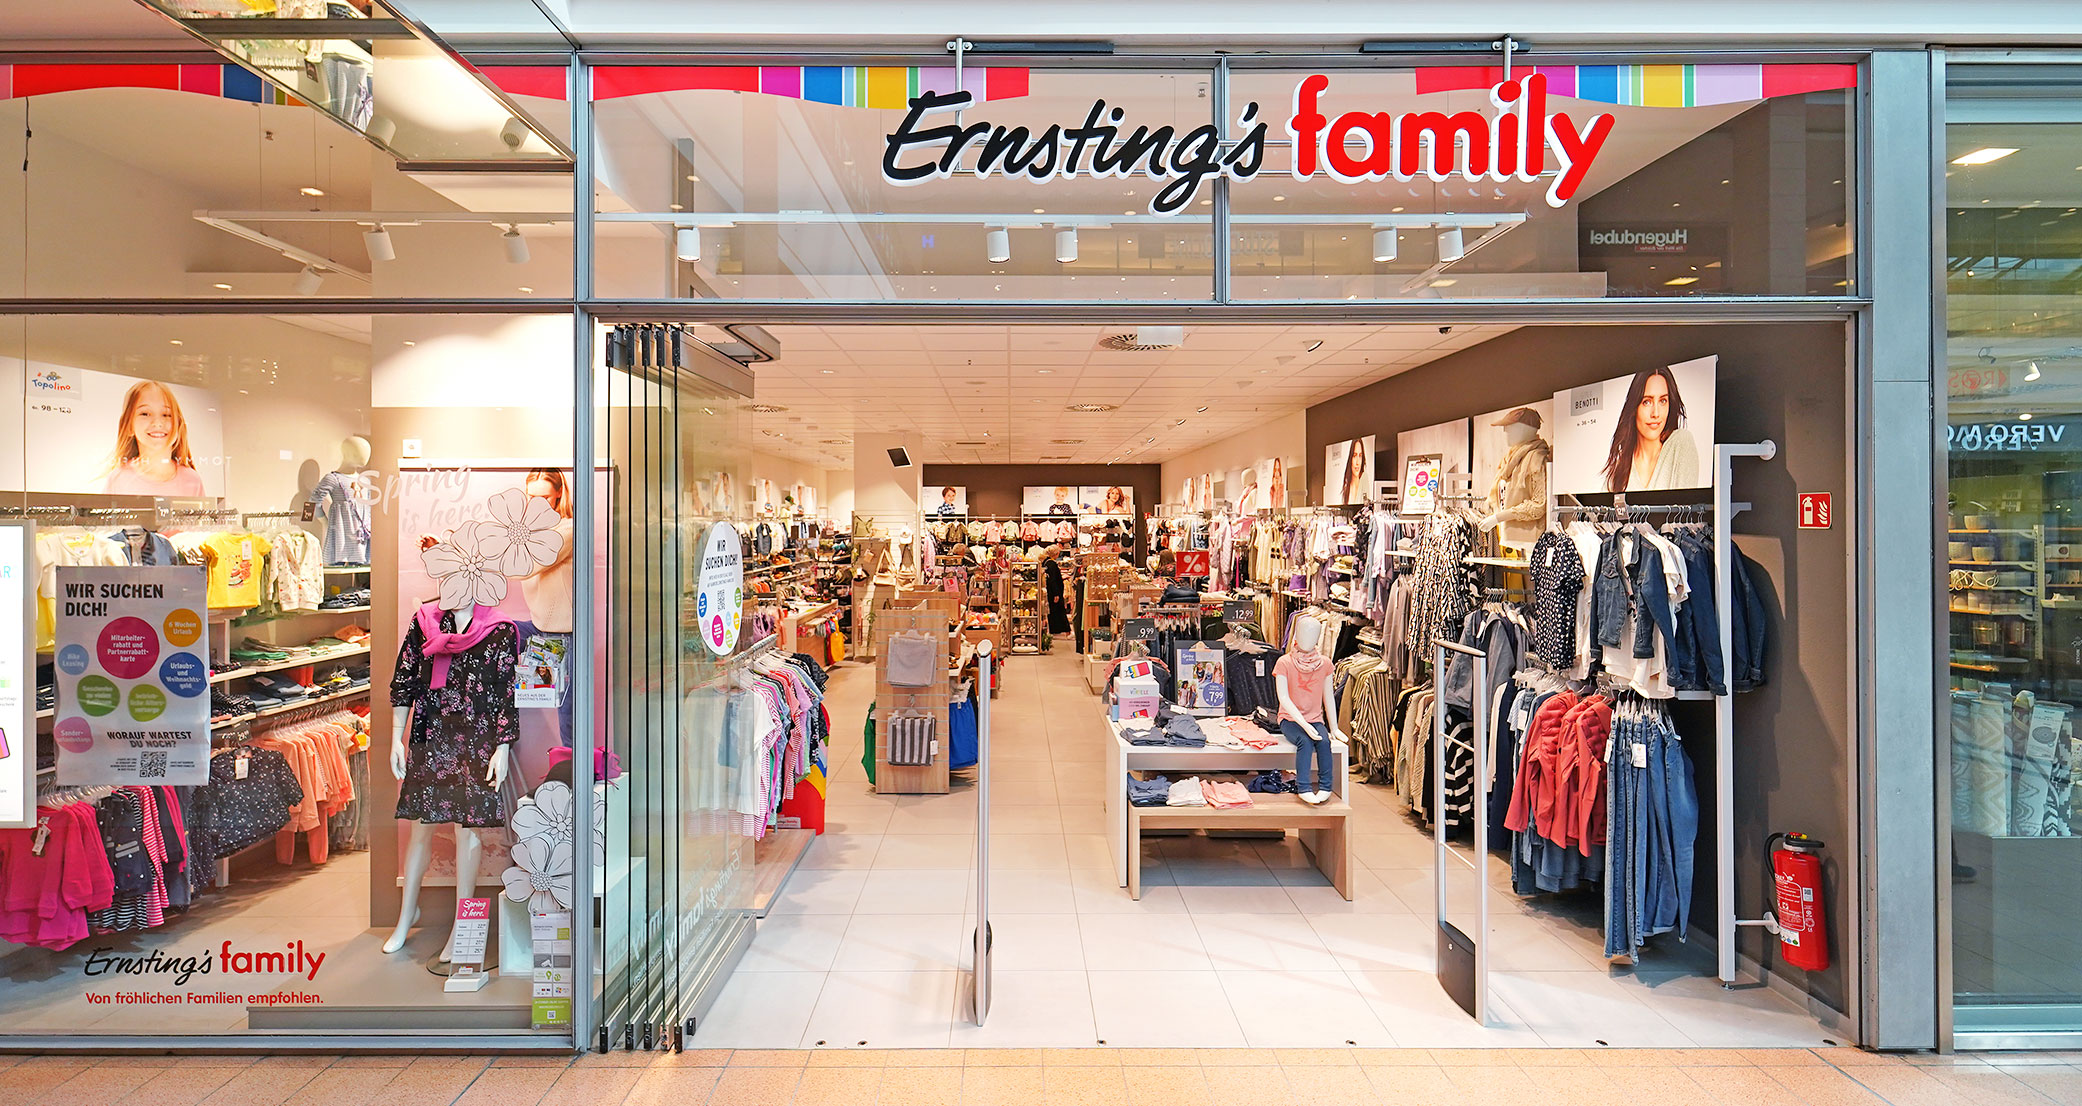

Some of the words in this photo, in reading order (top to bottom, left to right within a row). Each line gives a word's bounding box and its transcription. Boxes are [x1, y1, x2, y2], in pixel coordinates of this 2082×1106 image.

[882, 89, 1268, 216] Ernsting's
[1293, 73, 1616, 208] family
[32, 379, 71, 391] Topolino
[1574, 397, 1599, 410] BENOTTI
[355, 462, 472, 515] Spring
[402, 509, 420, 535] is
[428, 498, 489, 529] here.
[65, 583, 95, 599] WIR
[100, 583, 164, 599] SUCHEN
[65, 602, 108, 617] DICH!
[113, 641, 131, 649] rabatt
[132, 641, 143, 649] und
[107, 648, 149, 656] Partnerrabatt-
[119, 655, 136, 663] karte
[170, 662, 195, 670] Urlaubs-
[107, 731, 146, 740] WORAUF
[149, 731, 192, 740] WARTEST
[129, 740, 143, 748] DU
[146, 740, 177, 748] NOCH?
[463, 900, 487, 910] Spring
[84, 946, 213, 986] Ernsting's
[219, 940, 326, 981] family
[85, 992, 111, 1004] Von
[115, 991, 182, 1004] fröhlichen
[186, 991, 243, 1004] Familien
[247, 991, 324, 1007] empfohlen.
